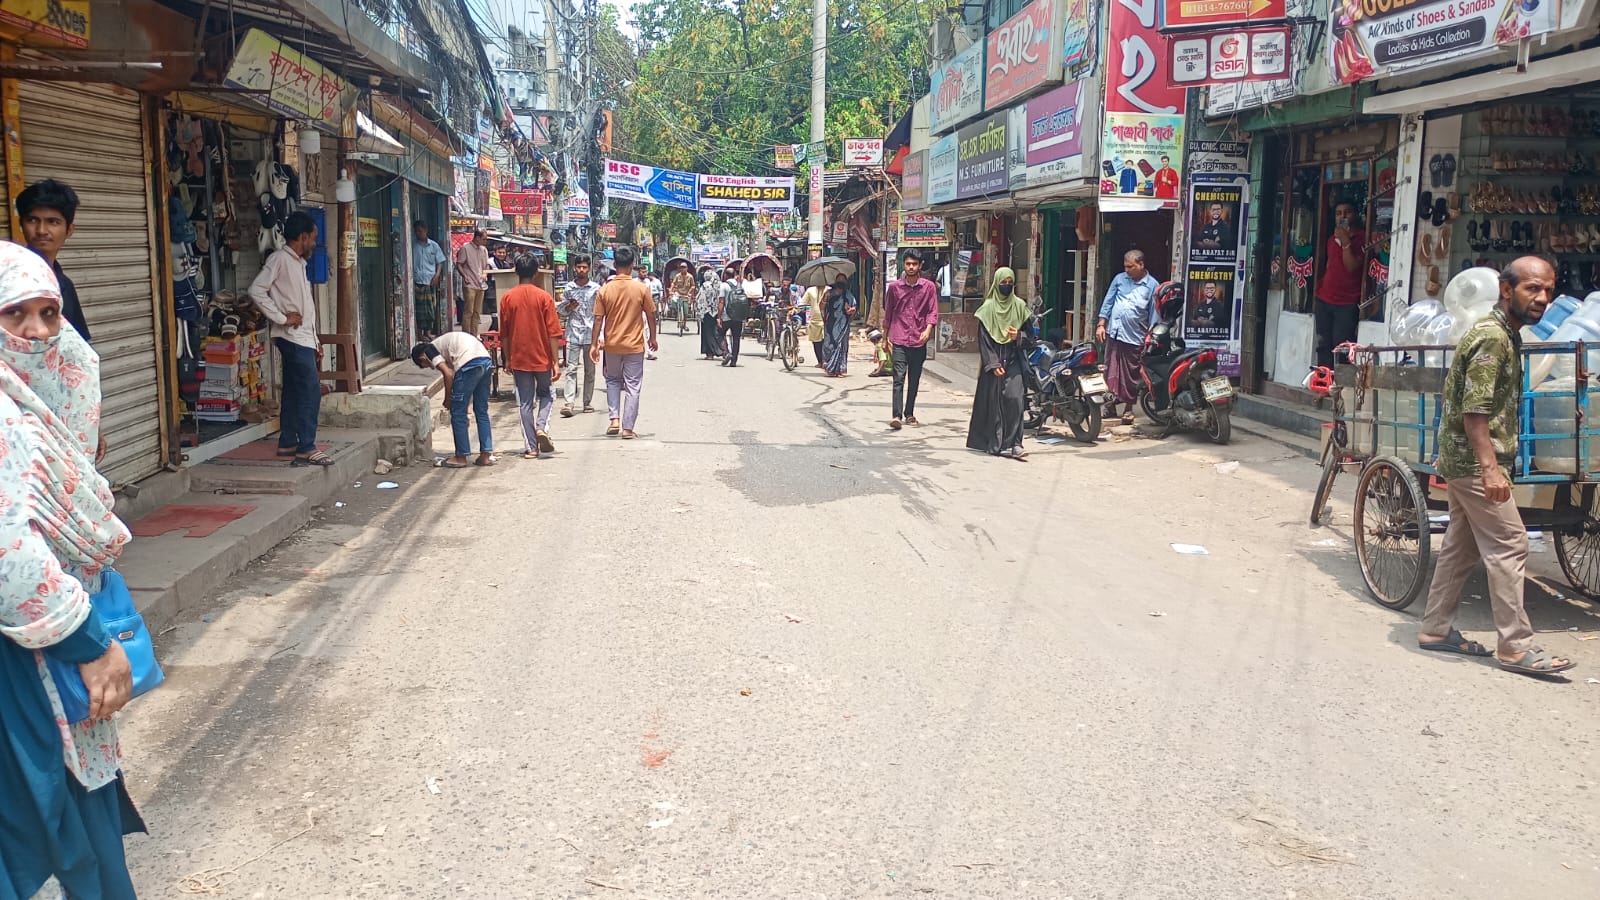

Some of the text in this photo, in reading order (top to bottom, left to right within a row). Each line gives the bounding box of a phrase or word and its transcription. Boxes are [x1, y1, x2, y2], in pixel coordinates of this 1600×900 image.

[1368, 0, 1496, 39] All Kinds of Shoes & Sandals
[1387, 29, 1471, 56] Ladies & Kids Collection
[1215, 60, 1245, 72] নগদ
[1111, 121, 1174, 142] পাঞ্জাবী পার্ক
[608, 162, 641, 176] HSC
[971, 156, 1006, 178] FURNITURE
[661, 180, 693, 195] হাসিব
[707, 176, 724, 184] HSC
[726, 177, 756, 185] English
[705, 186, 786, 199] SHAHED SIR
[1195, 191, 1240, 201] CHEMISTRY
[1189, 270, 1233, 280] CHEMISTRY
